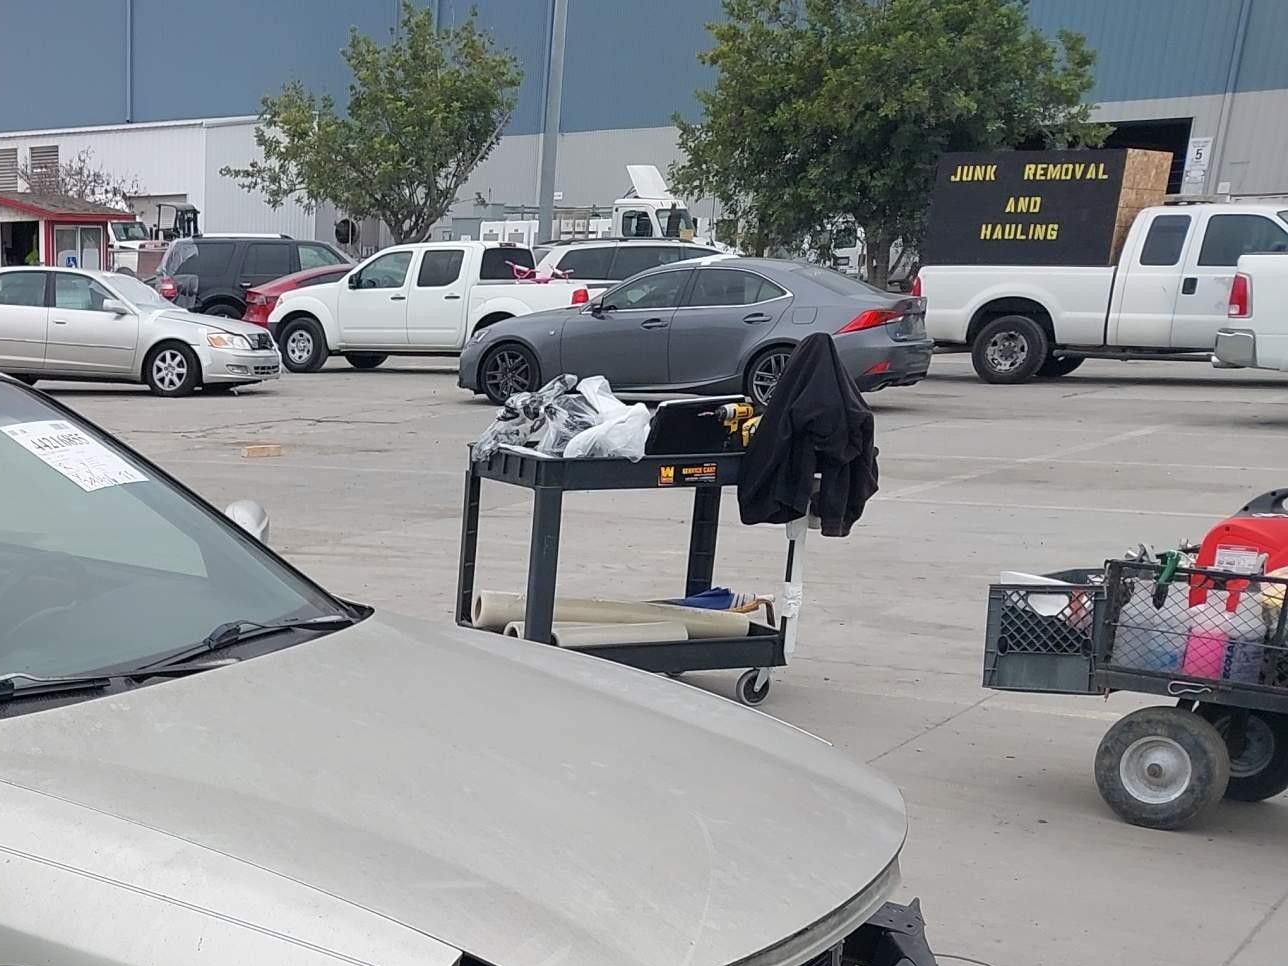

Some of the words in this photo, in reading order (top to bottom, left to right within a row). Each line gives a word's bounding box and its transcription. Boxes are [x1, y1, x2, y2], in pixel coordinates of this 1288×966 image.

[1194, 148, 1203, 160] 5
[950, 164, 997, 182] JUNK
[1023, 163, 1109, 181] REMOVAL
[1004, 196, 1041, 213] AND
[980, 223, 1059, 240] HAULING
